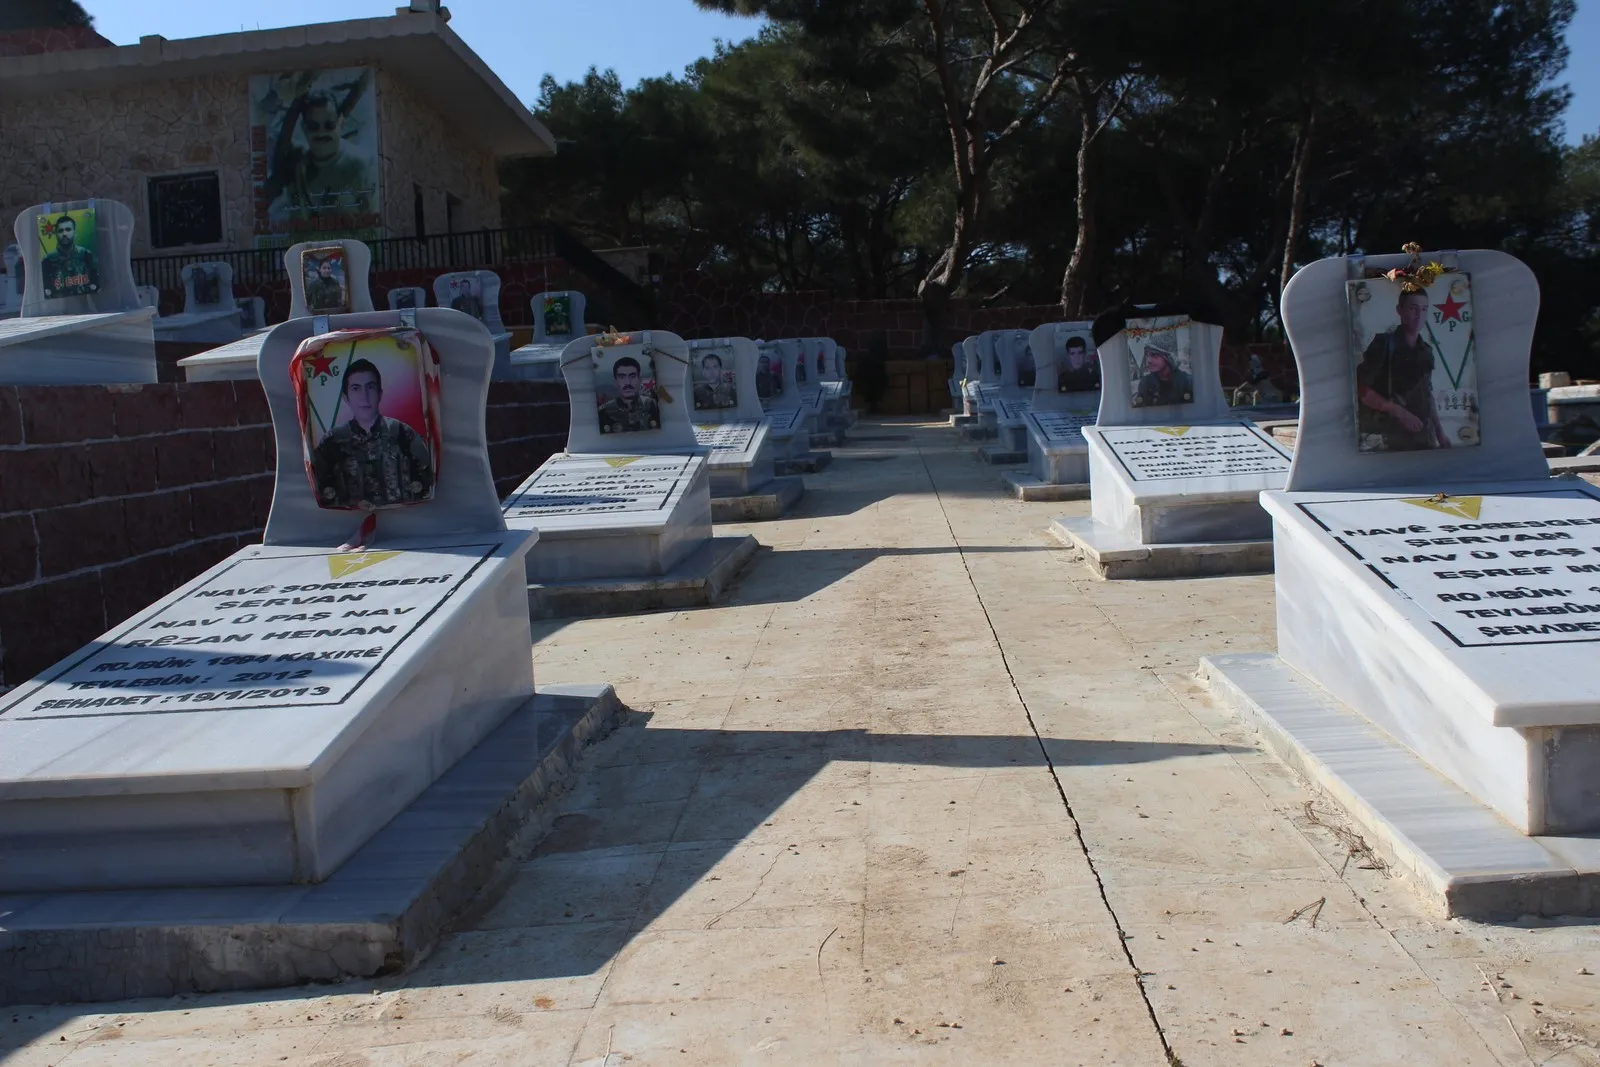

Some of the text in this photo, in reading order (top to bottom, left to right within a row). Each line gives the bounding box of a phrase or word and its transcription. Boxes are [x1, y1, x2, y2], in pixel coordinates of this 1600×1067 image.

[1433, 311, 1471, 332] YPG
[306, 365, 340, 386] YPG
[1343, 523, 1433, 536] NAVÊ
[1380, 553, 1458, 564] NAV
[1508, 547, 1586, 559] PAŞ
[1433, 566, 1554, 580] EŞREF
[195, 584, 277, 598] NAVÊ
[214, 593, 368, 610] ŞERVAN
[149, 606, 416, 629] NAV Û PAŞ NAV
[126, 625, 397, 648] RÊZAN HENAN
[228, 669, 314, 683] 2012
